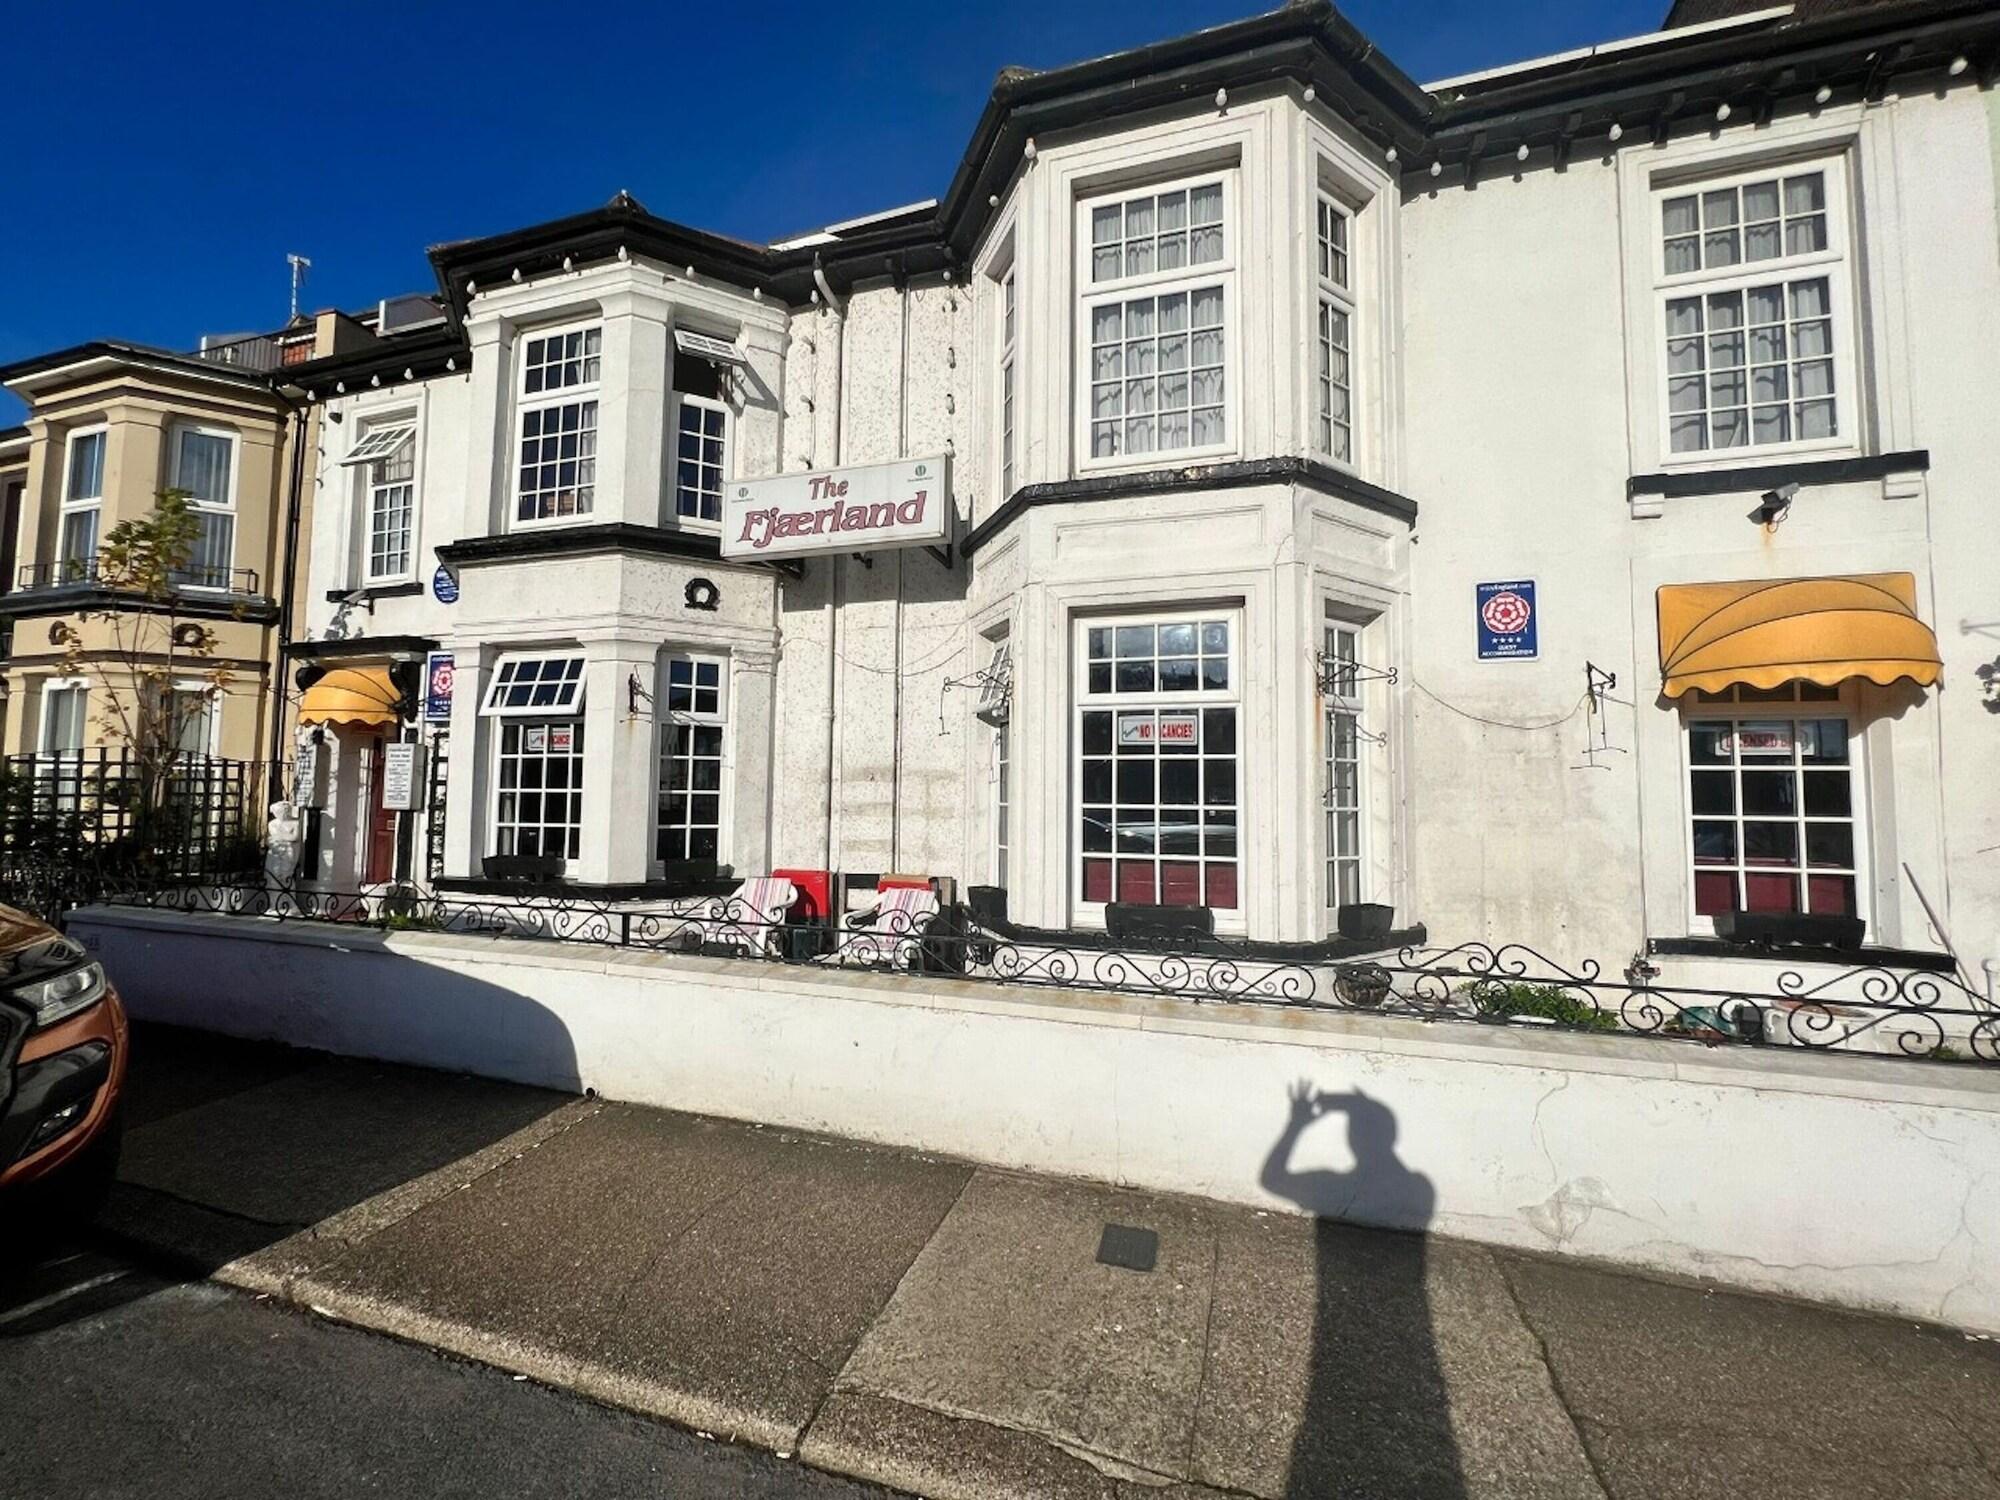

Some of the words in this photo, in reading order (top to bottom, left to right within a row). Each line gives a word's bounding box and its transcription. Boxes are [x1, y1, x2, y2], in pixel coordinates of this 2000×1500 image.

[809, 475, 849, 500] The
[736, 489, 928, 548] Fjærland
[1140, 724, 1151, 738] NO
[1152, 723, 1193, 738] CANCIES
